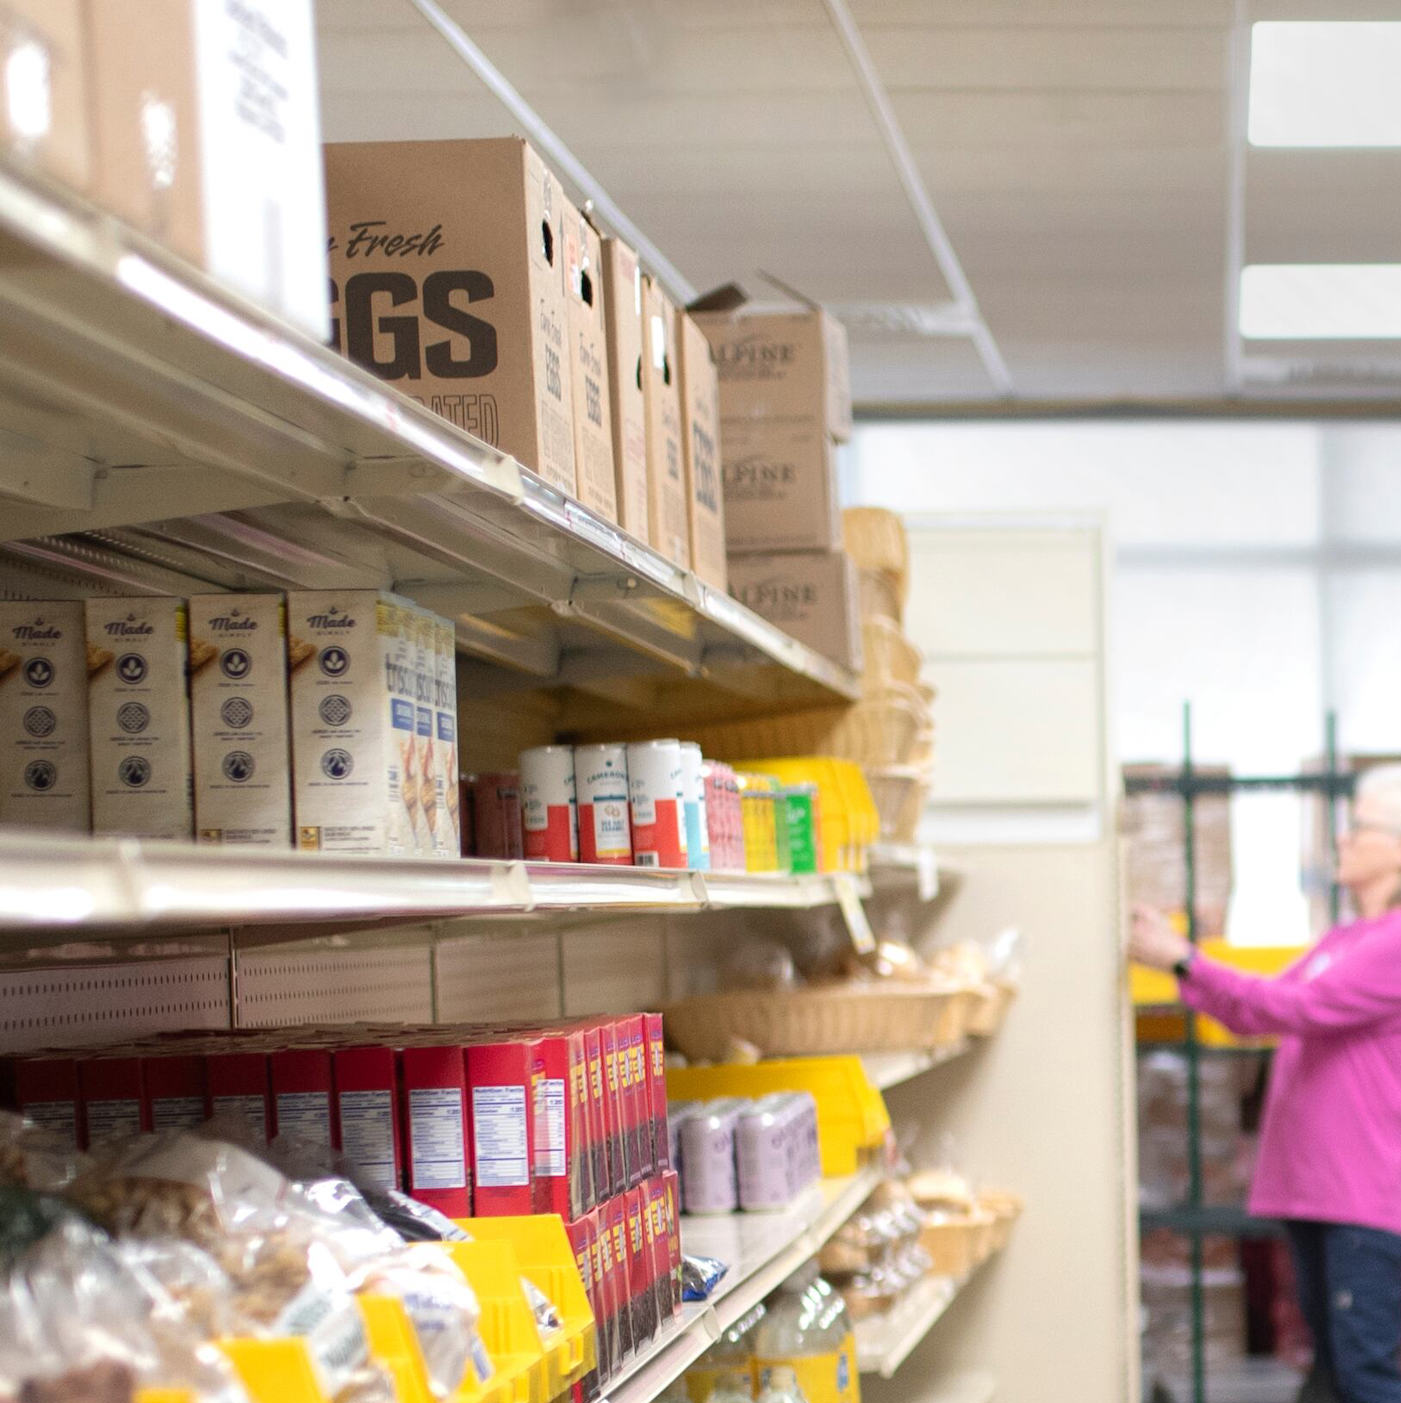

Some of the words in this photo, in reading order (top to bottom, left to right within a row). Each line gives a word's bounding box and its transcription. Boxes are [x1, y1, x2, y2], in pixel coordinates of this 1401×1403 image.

[346, 221, 446, 259] Fresh
[329, 270, 499, 380] GGS
[104, 622, 155, 636] Made
[209, 617, 258, 631] Made
[306, 614, 357, 630] Made
[12, 626, 63, 640] Made
